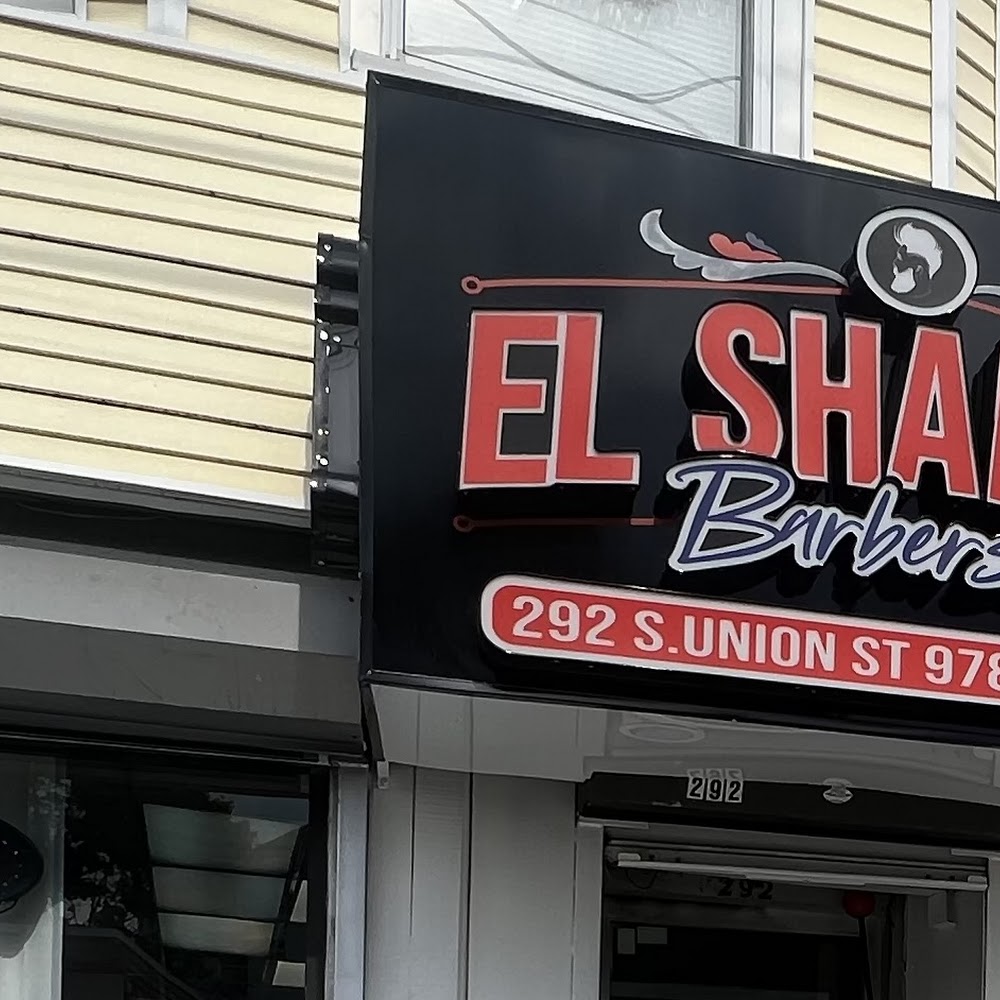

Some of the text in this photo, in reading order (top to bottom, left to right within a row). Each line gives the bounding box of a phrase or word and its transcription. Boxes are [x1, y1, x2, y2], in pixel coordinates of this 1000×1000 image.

[459, 309, 641, 490] EL
[511, 594, 617, 647] 292
[633, 611, 837, 673] S.UNION
[851, 635, 911, 680] ST
[688, 777, 743, 803] 292
[718, 878, 773, 900] 292
